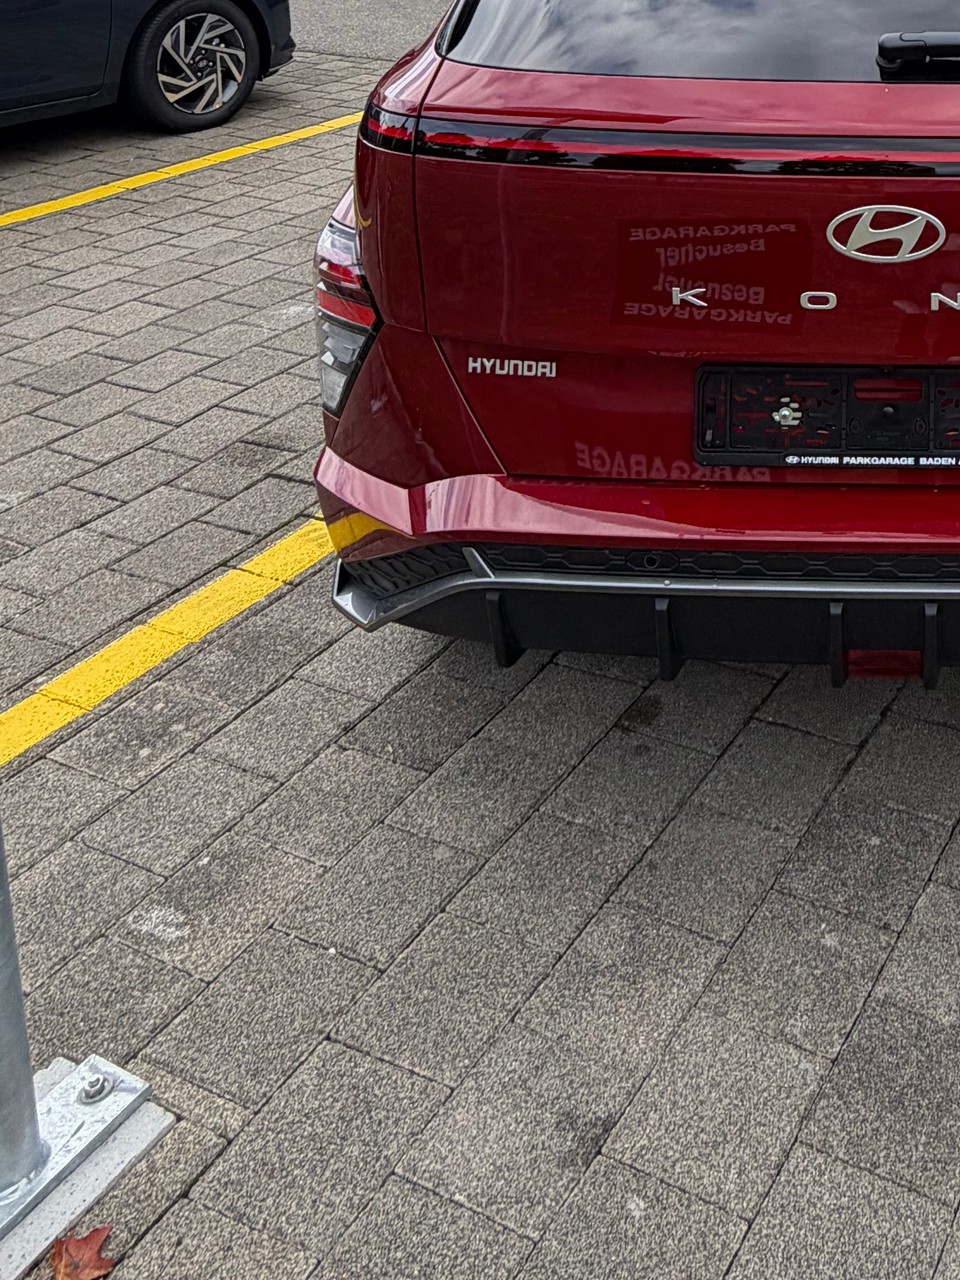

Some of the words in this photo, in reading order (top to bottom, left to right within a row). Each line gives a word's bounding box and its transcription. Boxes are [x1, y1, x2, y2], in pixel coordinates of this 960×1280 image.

[623, 302, 793, 325] PARKGARAGE
[467, 356, 557, 378] HYUNDAI
[800, 456, 839, 464] HYUNDAI
[842, 456, 915, 465] PARKGARAGE
[919, 457, 956, 465] BADEN
